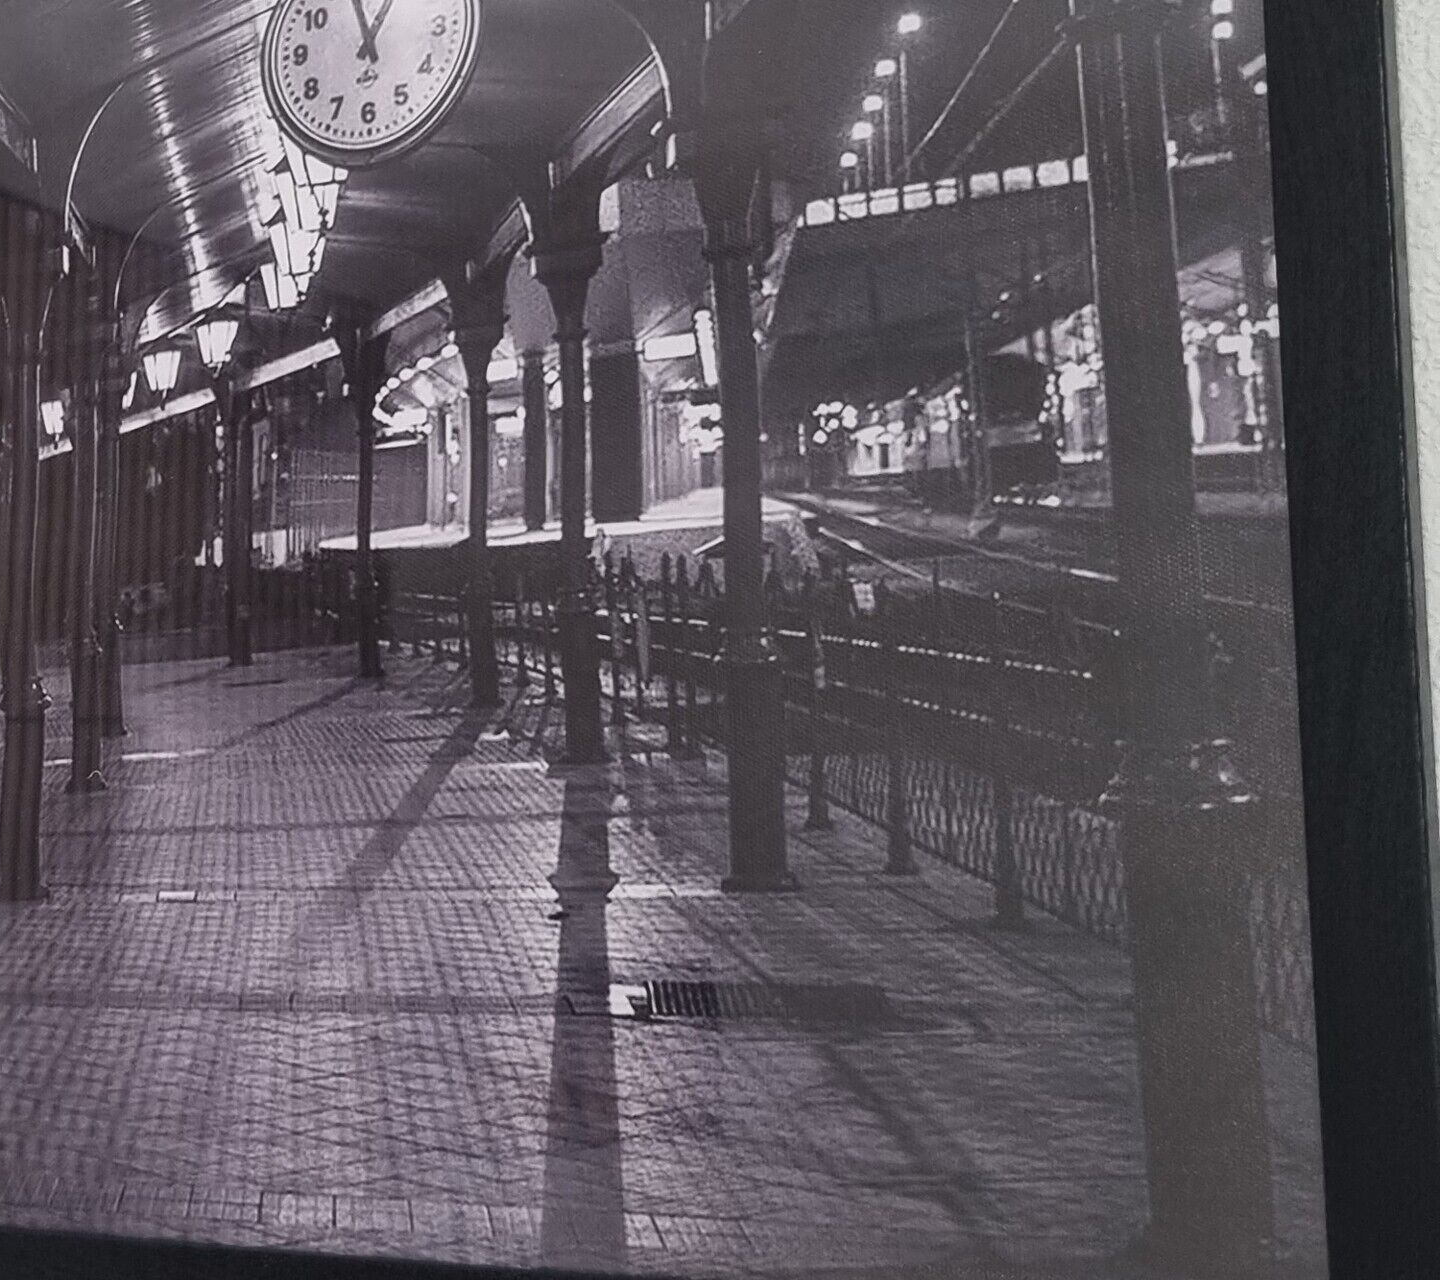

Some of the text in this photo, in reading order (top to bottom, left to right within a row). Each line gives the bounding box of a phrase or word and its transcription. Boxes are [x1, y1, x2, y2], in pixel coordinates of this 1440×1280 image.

[303, 7, 329, 33] 10
[431, 15, 447, 37] 3
[293, 44, 309, 66] 9
[417, 53, 434, 75] 4
[303, 77, 320, 101] 8
[394, 83, 409, 105] 5
[330, 96, 344, 121] 7
[361, 102, 376, 124] 6
